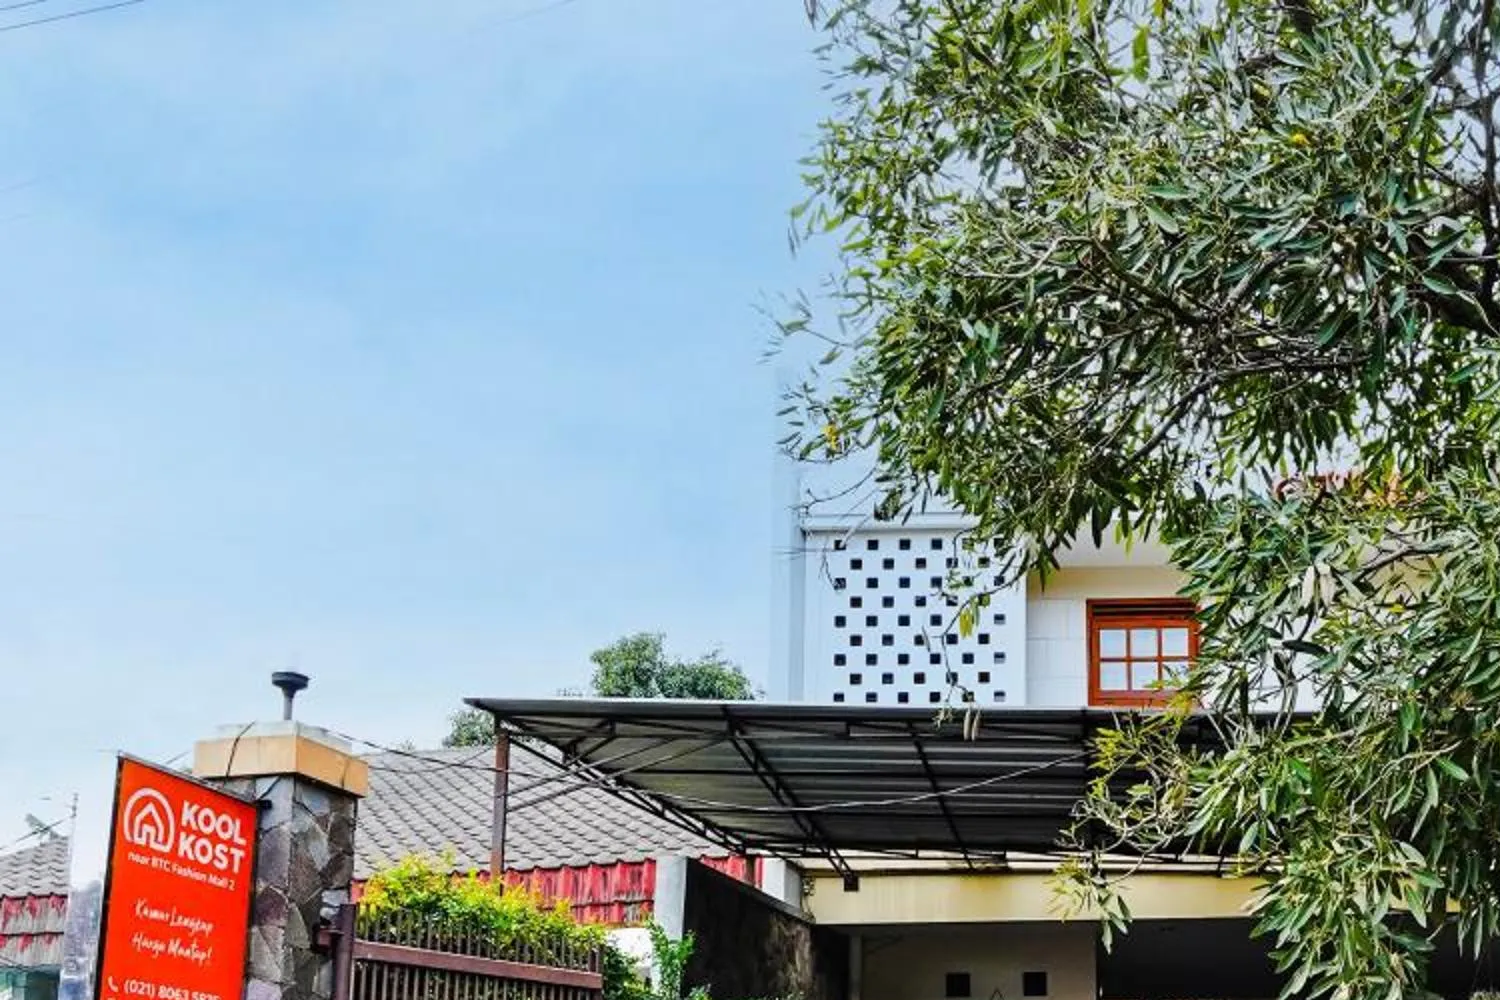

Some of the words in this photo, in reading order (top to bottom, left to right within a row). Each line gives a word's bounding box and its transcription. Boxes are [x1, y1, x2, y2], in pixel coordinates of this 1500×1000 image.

[181, 799, 247, 846] KOOL
[178, 831, 245, 874] KOST
[171, 863, 206, 882] Fashion
[228, 879, 235, 891] 2
[123, 979, 155, 999] (021)
